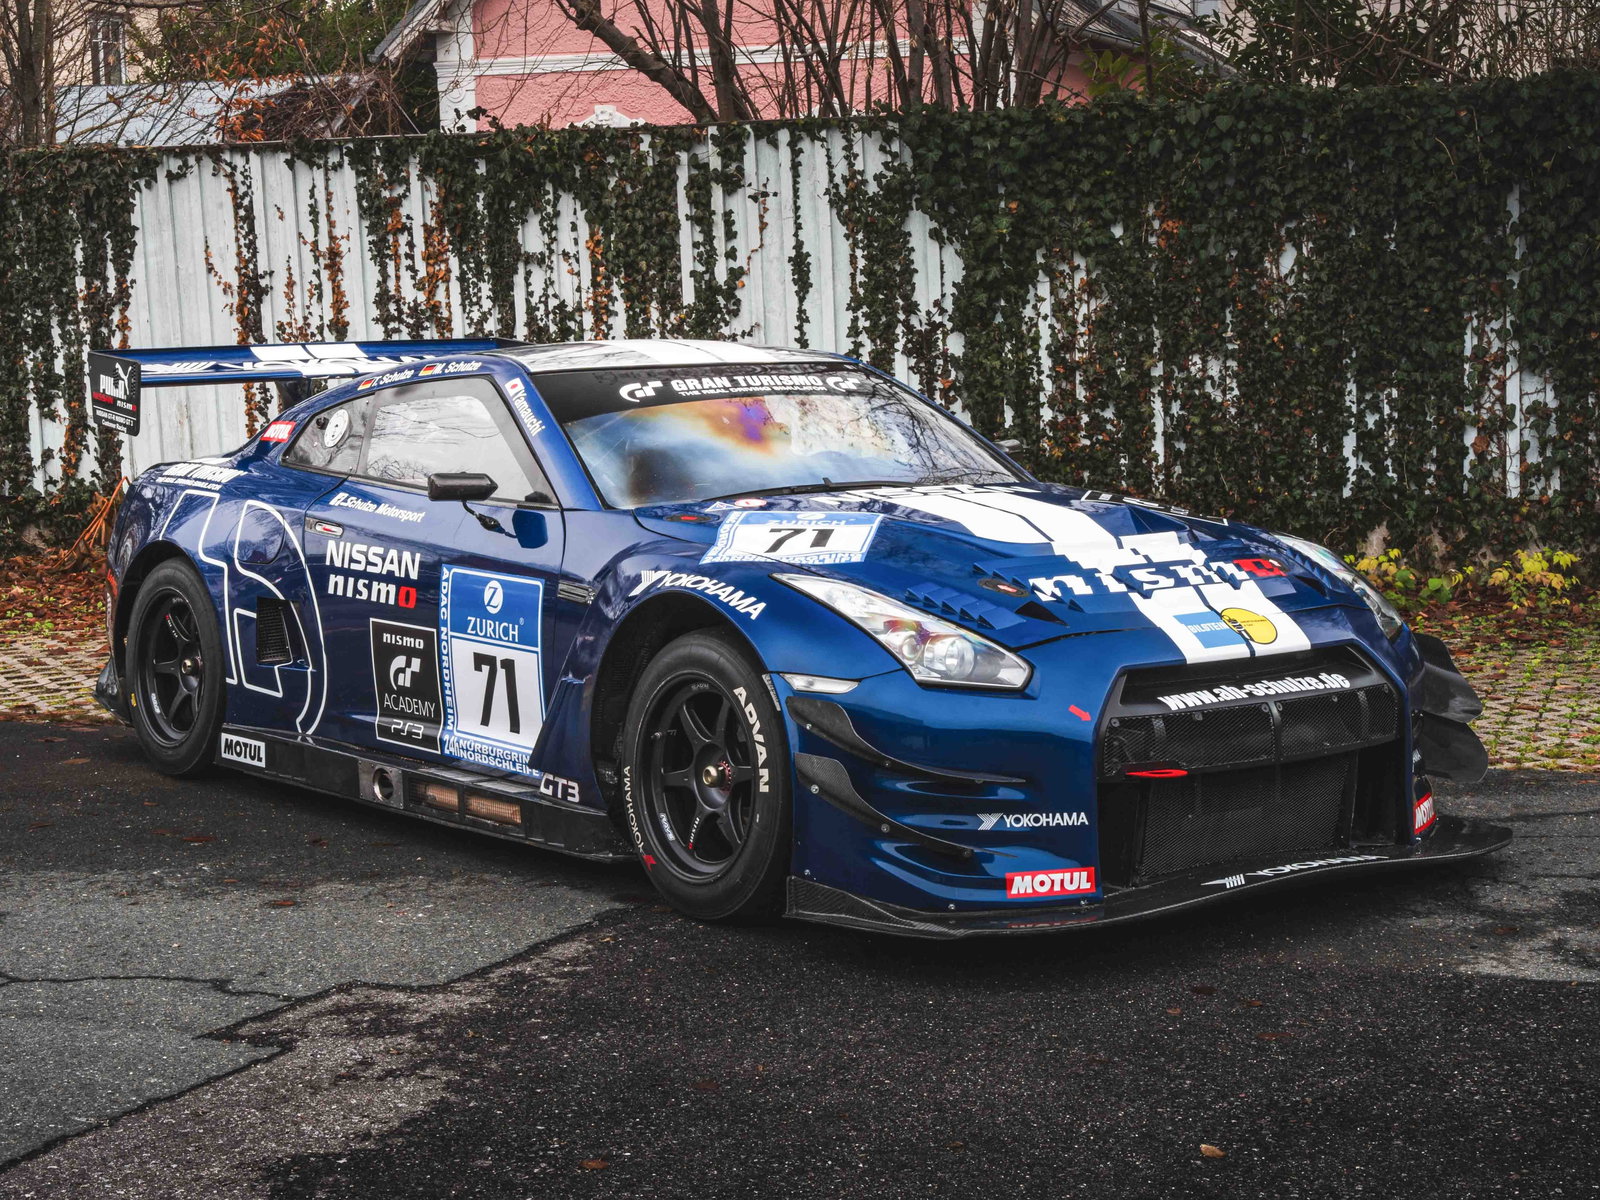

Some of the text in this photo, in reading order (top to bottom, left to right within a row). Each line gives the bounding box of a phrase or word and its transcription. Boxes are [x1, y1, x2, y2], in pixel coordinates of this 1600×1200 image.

[380, 369, 414, 384] Schulze
[445, 361, 482, 373] Schulze
[671, 375, 823, 392] GRAN TURISMO
[512, 389, 546, 437] Yamauchi
[375, 503, 426, 523] Motorsport
[764, 528, 835, 554] 71
[325, 539, 421, 580] NISSAN
[328, 573, 417, 609] nismo
[440, 566, 450, 621] ADAC
[1029, 558, 1288, 602] nismo
[658, 570, 768, 621] YOKOHAMA
[466, 616, 519, 643] ZURICH
[383, 692, 436, 718] ACADEMY
[472, 652, 521, 735] 71
[1157, 672, 1351, 711] www.ah-schulze.de
[391, 719, 425, 740] PS3
[732, 685, 770, 793] ADVAN
[223, 738, 263, 762] MOTUL
[443, 733, 530, 764] 24h NÜRBURGRIN
[540, 773, 580, 803] GT3
[623, 766, 644, 853] YOKOHAMA
[1003, 811, 1089, 828] YOKOHAMA
[1246, 855, 1390, 876] YOKOHAMA
[1010, 869, 1092, 895] MOTUL
